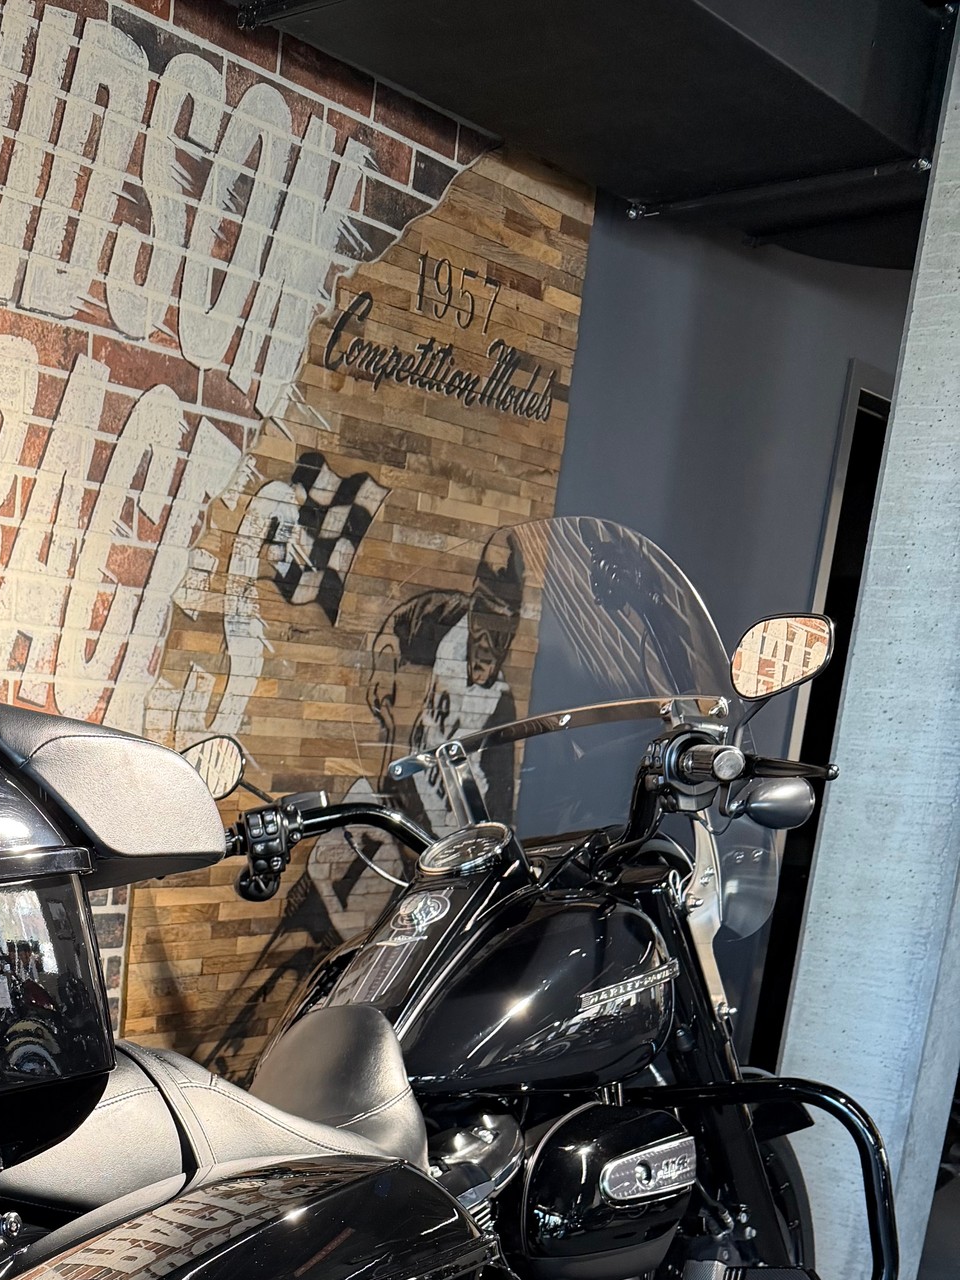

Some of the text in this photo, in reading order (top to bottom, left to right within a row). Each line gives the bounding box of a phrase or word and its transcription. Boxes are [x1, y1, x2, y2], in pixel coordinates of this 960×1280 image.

[414, 250, 503, 336] 1957
[322, 290, 554, 423] Competition Models
